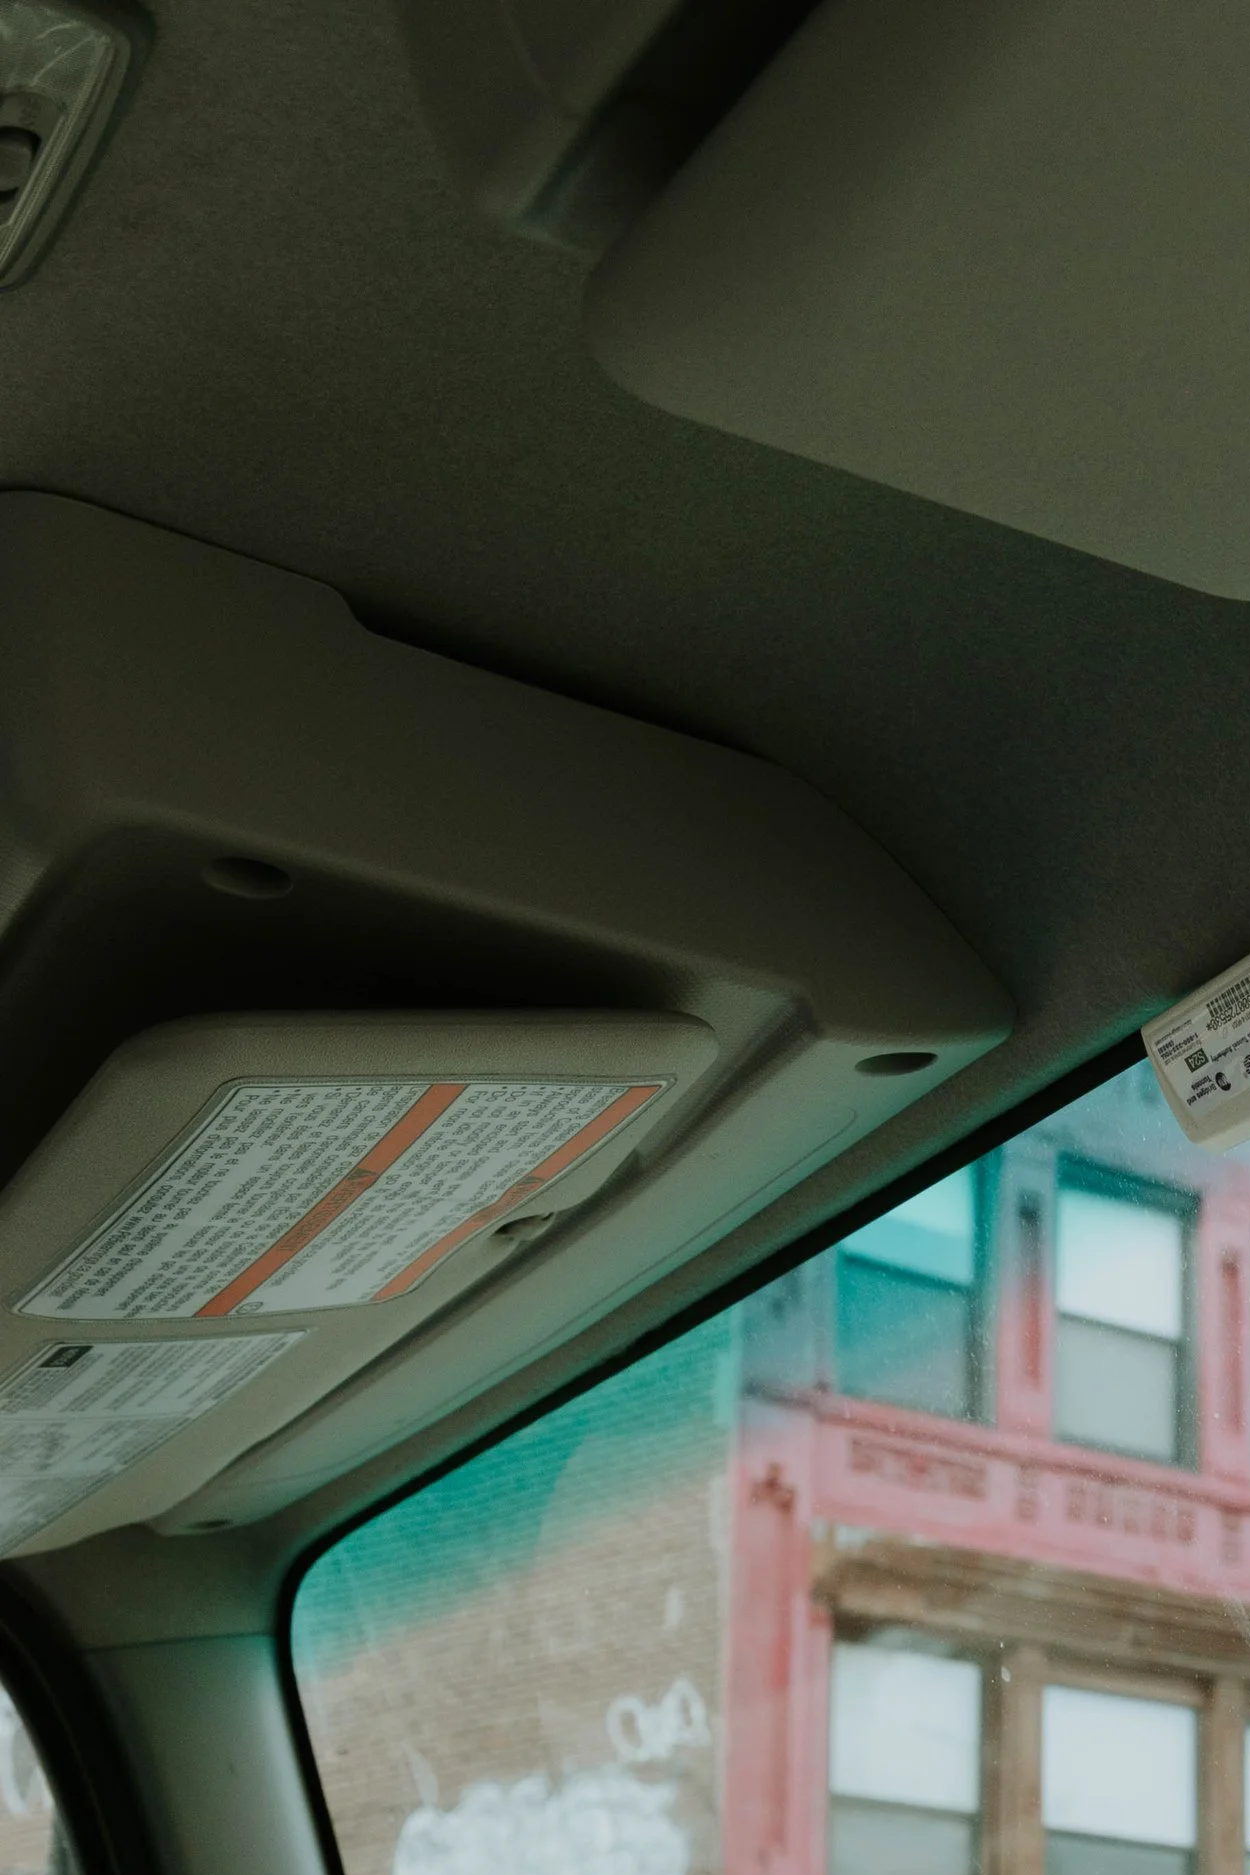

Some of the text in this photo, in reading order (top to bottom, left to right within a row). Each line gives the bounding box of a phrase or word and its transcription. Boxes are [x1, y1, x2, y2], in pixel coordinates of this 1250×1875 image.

[1186, 1049, 1207, 1069] S24
[279, 1093, 301, 1104] Ne
[323, 1092, 342, 1100] Si
[365, 1085, 384, 1096] de
[371, 1085, 403, 1111] agents
[466, 1090, 488, 1103] For
[484, 1090, 507, 1102] Do
[503, 1090, 526, 1102] Do
[577, 1086, 602, 1104] state
[233, 1094, 260, 1112] Pour
[258, 1094, 281, 1105] Ne
[376, 1085, 427, 1128] L'inspiration
[517, 1099, 535, 1107] in
[526, 1091, 562, 1116] Always
[531, 1086, 583, 1129] reproductive
[303, 1104, 325, 1121] vous
[317, 1092, 361, 1127] Démarrez
[332, 1100, 370, 1131] cancers,
[441, 1108, 468, 1127] more
[468, 1106, 488, 1118] not
[487, 1105, 507, 1118] not
[504, 1110, 521, 1120] an
[214, 1115, 237, 1130] plus
[233, 1108, 267, 1133] laissez
[248, 1108, 284, 1138] modifiez
[261, 1093, 317, 1147] vers l'extérieur.
[505, 1120, 529, 1136] start
[286, 1125, 312, 1140] êtes
[334, 1115, 376, 1151] chimiques
[362, 1131, 380, 1141] de
[452, 1122, 474, 1135] idle
[456, 1121, 491, 1146] modify
[218, 1136, 238, 1149] pas
[436, 1138, 458, 1150] the
[466, 1123, 507, 1155] enclosed
[487, 1139, 508, 1153] and
[233, 1142, 254, 1155] pas
[267, 1143, 292, 1161] dans
[287, 1141, 316, 1160] faites
[346, 1144, 367, 1157] gaz
[400, 1131, 447, 1170] information
[186, 1162, 215, 1185] moteur
[213, 1168, 230, 1177] ne
[256, 1164, 272, 1173] un
[409, 1154, 440, 1177] engine
